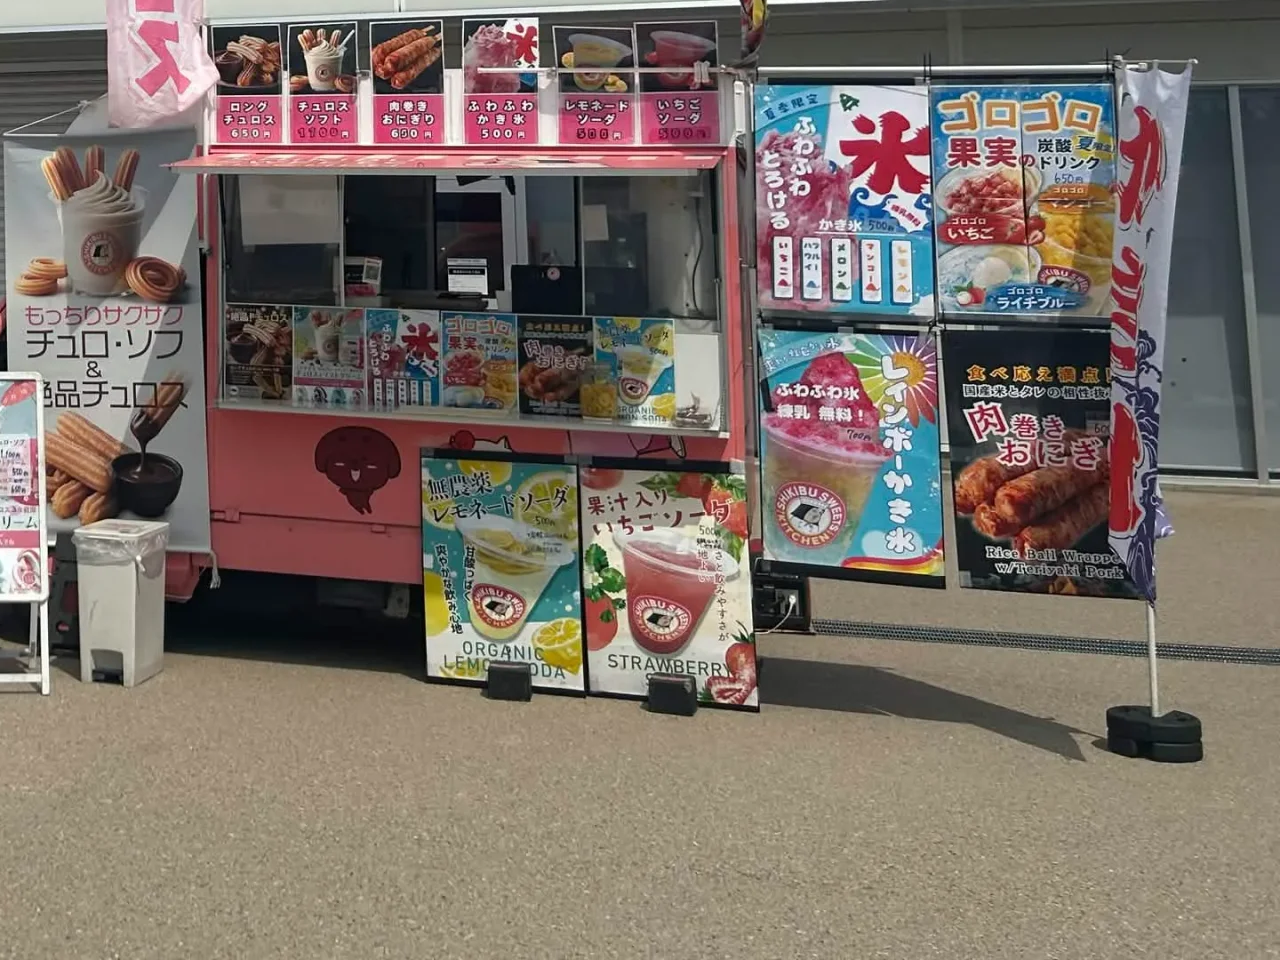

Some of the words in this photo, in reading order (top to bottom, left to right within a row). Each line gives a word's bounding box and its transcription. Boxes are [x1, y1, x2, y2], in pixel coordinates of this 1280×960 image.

[229, 101, 269, 113] ロング
[297, 101, 350, 112] チュロス
[388, 101, 427, 112] 肉巻き
[468, 100, 534, 112] ふわふわ
[564, 100, 629, 111] レモネード
[657, 99, 701, 110] いちご
[763, 93, 819, 121] 夏季限定
[938, 91, 1102, 134] ゴロゴロ
[223, 114, 276, 125] チュロス
[305, 114, 343, 125] ソフト
[381, 113, 435, 125] おにぎり
[477, 113, 526, 125] かき氷
[577, 114, 617, 125] ソーダ
[658, 113, 701, 125] ソーダ
[839, 111, 930, 195] 氷
[1038, 138, 1072, 153] 炭酸
[789, 117, 817, 197] ふわふわ
[1040, 156, 1100, 170] ドリンク
[763, 150, 790, 230] とろける
[818, 219, 862, 232] かき氷
[951, 217, 987, 225] ゴロゴロ
[947, 227, 995, 240] いちご
[837, 244, 847, 278] メロン
[1007, 286, 1044, 295] ゴロゴロ
[997, 297, 1076, 310] ライチブルー
[25, 305, 183, 326] もっちりサクサク
[445, 315, 512, 336] ゴロゴロ
[26, 329, 183, 359] チュロ・ソフ
[401, 322, 438, 361] 氷
[86, 360, 102, 378] &
[776, 383, 860, 400] ふわふわ氷
[962, 384, 1112, 400] 国産米とタレの相性抜
[963, 401, 1066, 443] 肉巻き
[880, 353, 916, 554] レインボーかき氷
[996, 437, 1104, 471] おにぎ
[428, 471, 492, 501] 無農薬
[432, 485, 570, 523] レモネードソーダ
[587, 489, 668, 516] 果汁入り
[776, 485, 818, 510] SHIKIBU
[819, 492, 843, 531] SWEETS
[593, 499, 734, 536] いちごソーダ
[985, 546, 1019, 560] Rice
[1026, 548, 1057, 562] Ball
[1062, 550, 1120, 565] Wrappe
[994, 562, 1081, 577] w/Teriyaki
[1085, 566, 1125, 580] Pork
[436, 544, 464, 635] 爽やかな飲み心地
[462, 640, 545, 661] ORGANIC
[443, 654, 491, 673] LEMO
[529, 662, 566, 680] ODA
[607, 654, 732, 677] STRAWBERRY
